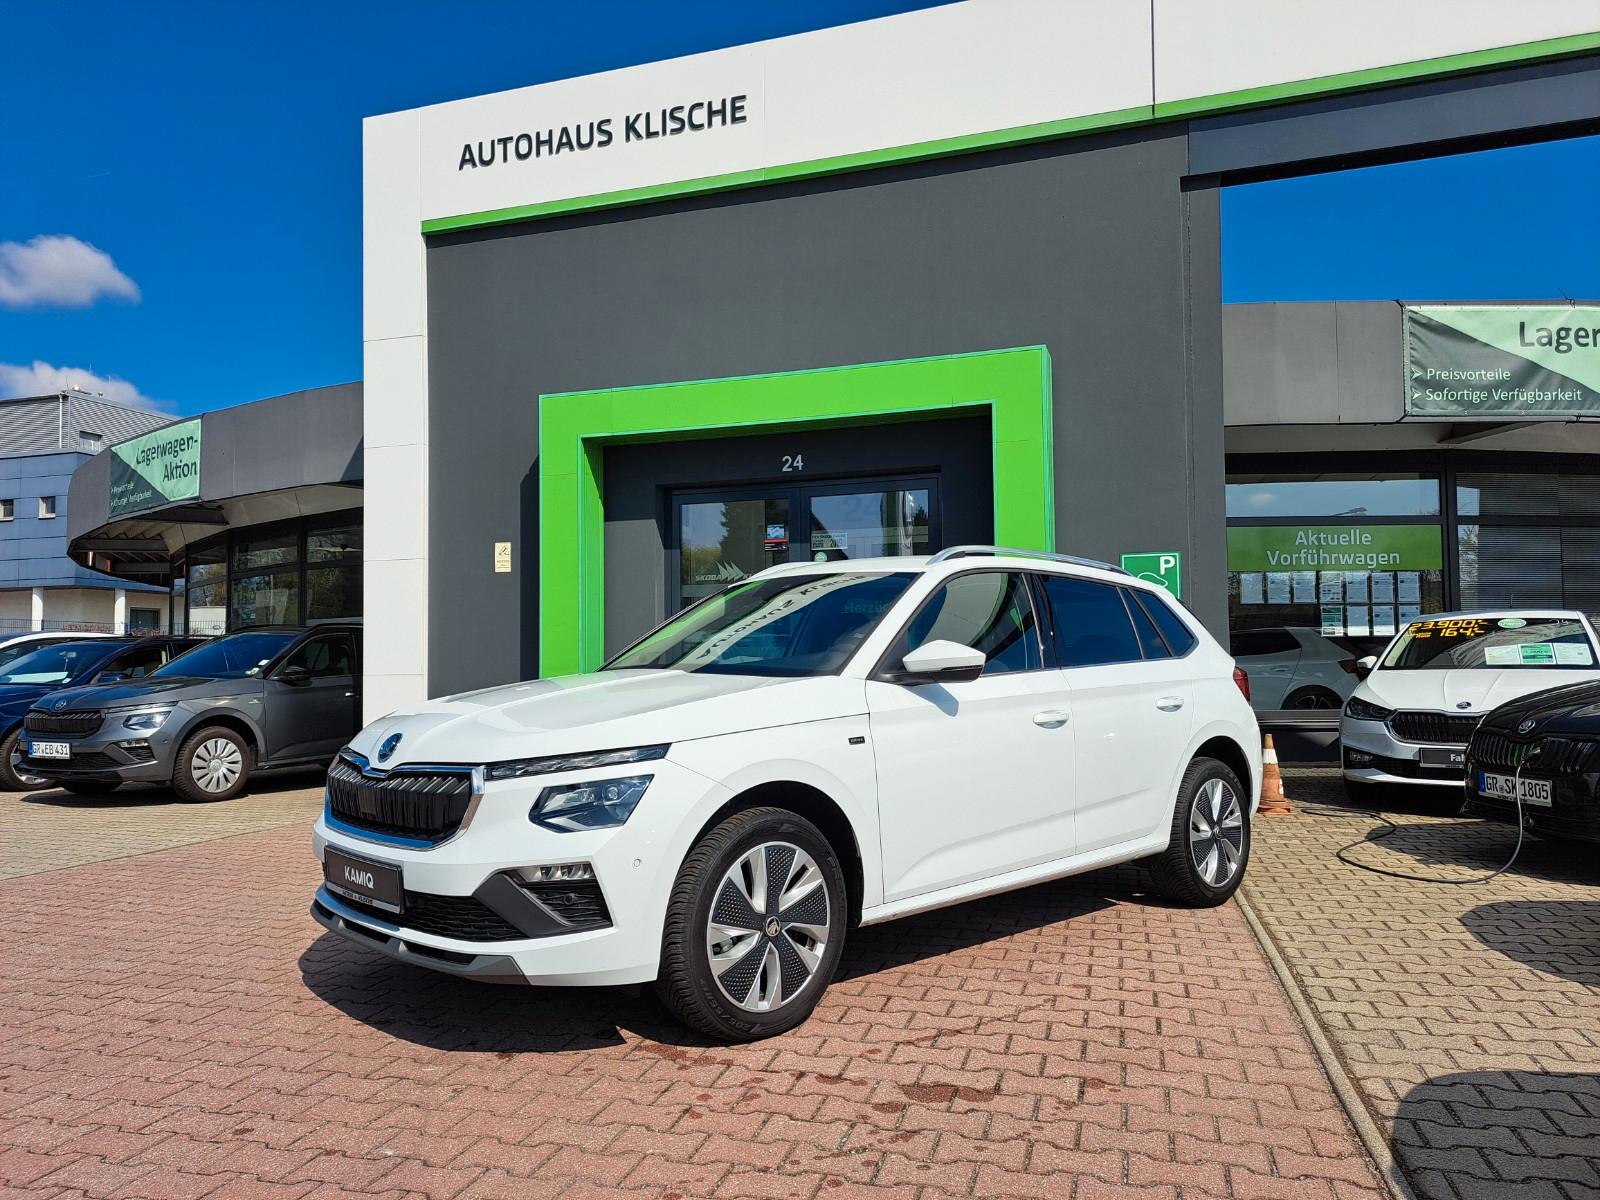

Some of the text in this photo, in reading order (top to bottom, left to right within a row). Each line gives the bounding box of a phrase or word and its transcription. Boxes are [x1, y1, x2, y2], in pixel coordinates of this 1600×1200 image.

[458, 95, 747, 171] AUTOHAUS KLISCHE
[1427, 368, 1511, 380] Preisvorteile
[1425, 388, 1582, 404] Sofortige Verfügbarkeit
[136, 435, 198, 467] Lagerwagen-
[163, 459, 197, 482] Aktion
[782, 454, 804, 472] 24
[1295, 529, 1372, 545] Aktuelle
[1160, 556, 1175, 575] P
[1267, 549, 1400, 568] Vorführwagen
[54, 744, 69, 756] 431
[1486, 775, 1498, 792] GR
[1520, 780, 1549, 800] 1805
[344, 865, 374, 889] KAMIQ
